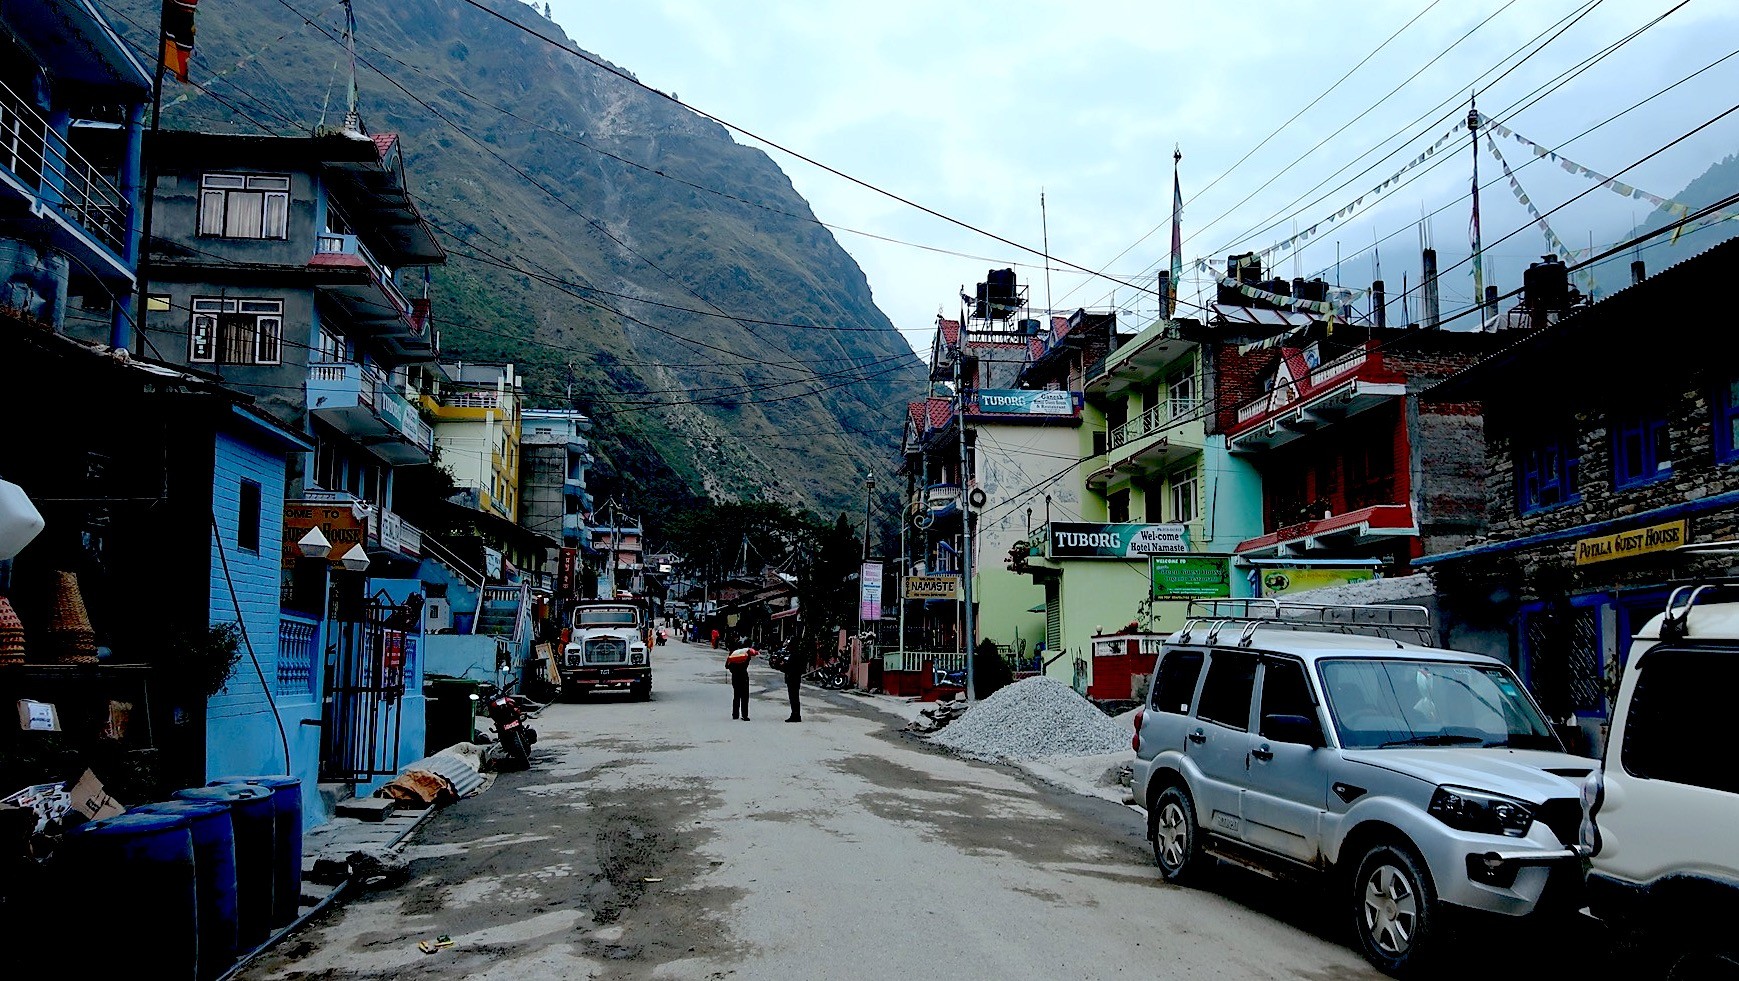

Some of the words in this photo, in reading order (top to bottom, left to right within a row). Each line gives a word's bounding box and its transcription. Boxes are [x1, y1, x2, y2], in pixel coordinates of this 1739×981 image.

[982, 395, 1026, 407] TUBORG
[284, 509, 313, 518] OME
[321, 509, 341, 518] TO
[1055, 532, 1121, 548] TUBORG
[1644, 528, 1681, 547] HOUSE
[1130, 543, 1151, 552] Hotel
[1152, 543, 1186, 552] Namaste
[911, 582, 955, 592] NAMASTE
